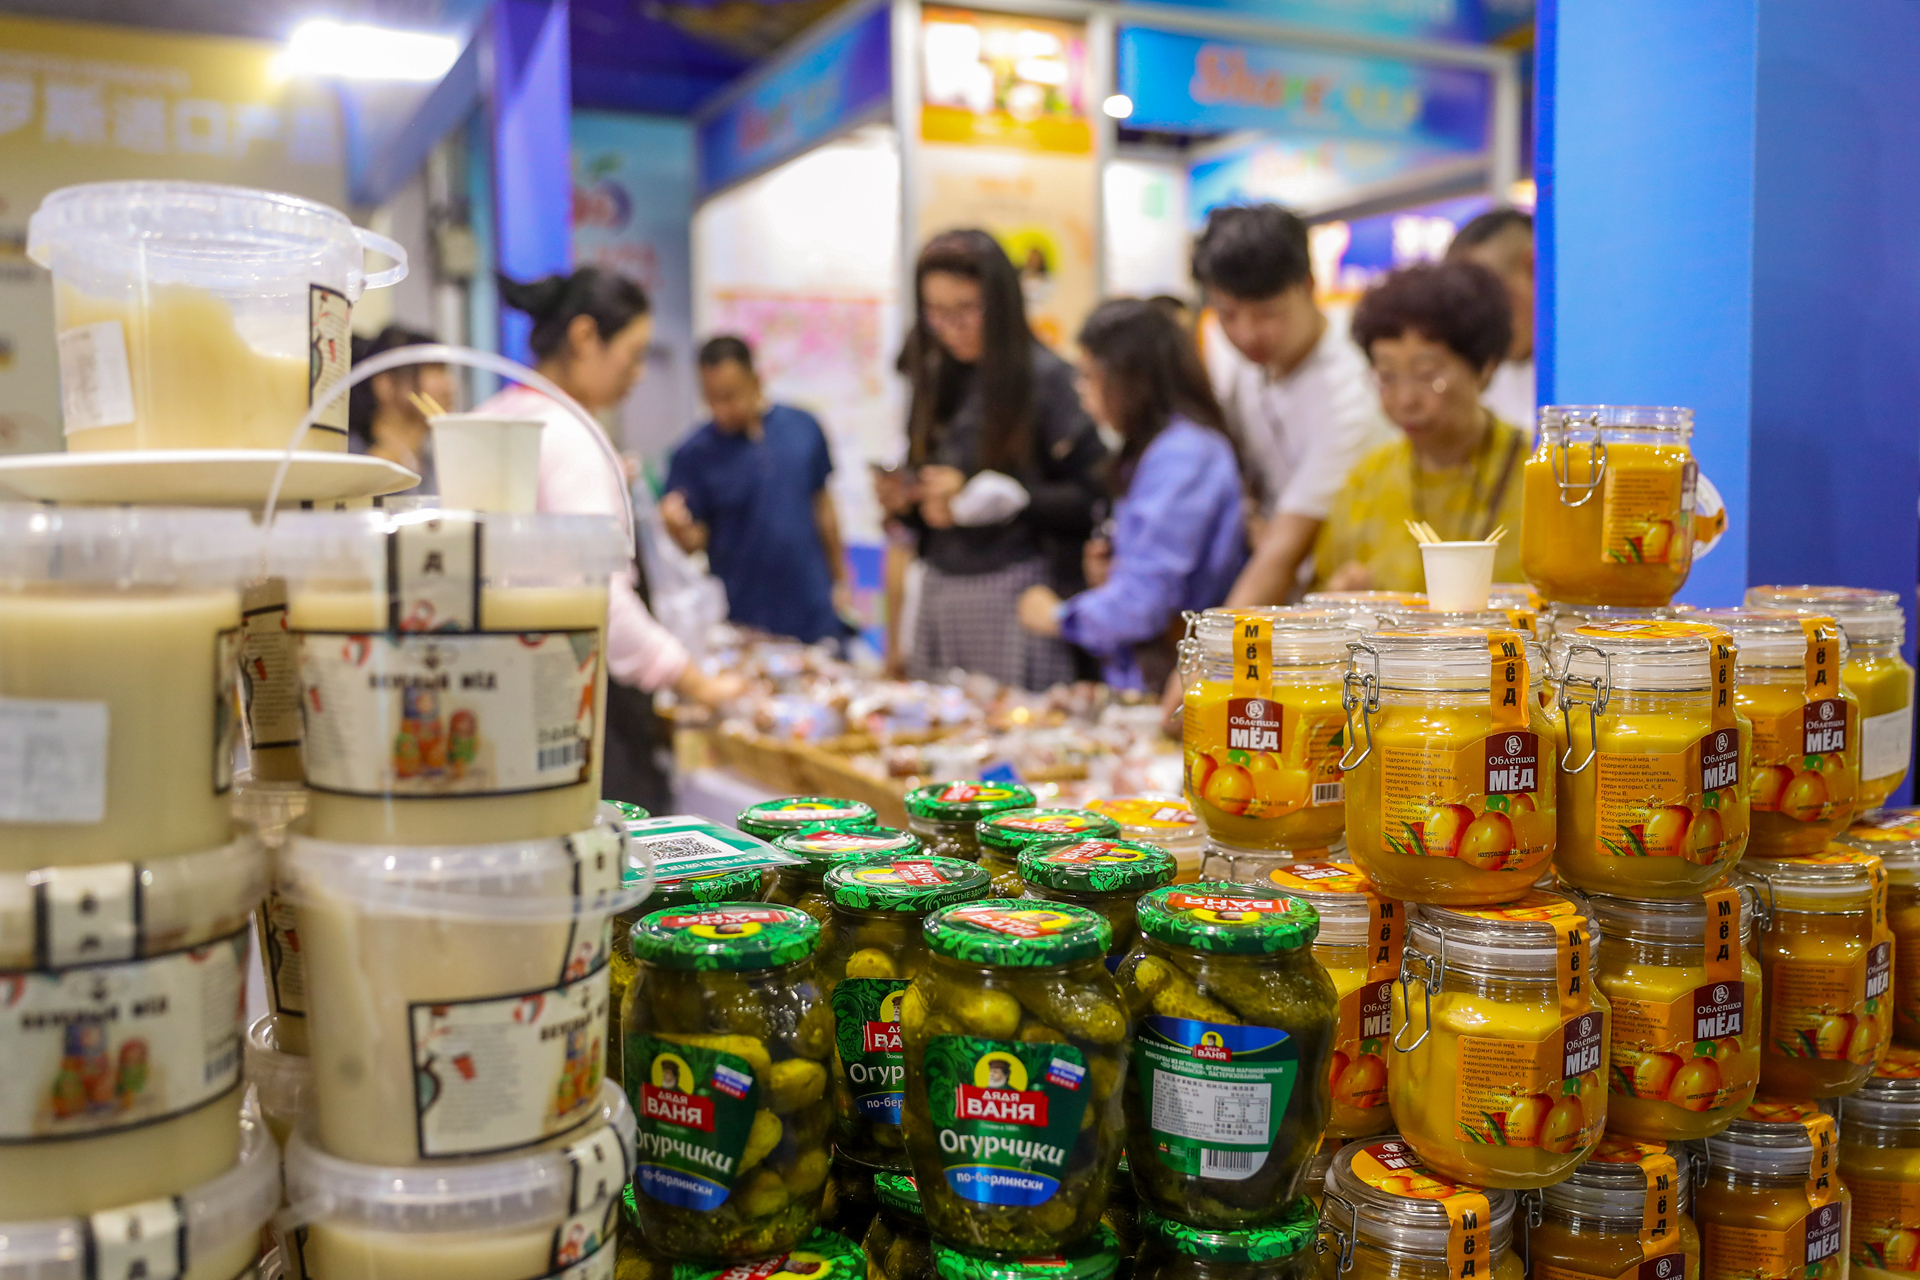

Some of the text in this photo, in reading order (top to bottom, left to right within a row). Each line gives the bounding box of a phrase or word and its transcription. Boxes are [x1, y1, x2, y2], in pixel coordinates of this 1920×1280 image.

[1244, 624, 1260, 681] Мёд
[1813, 629, 1828, 686] Мёд
[1501, 641, 1518, 707] Мёд
[1716, 643, 1730, 708] Мёд
[1230, 715, 1280, 728] Облепиха
[1805, 719, 1845, 730] Облепиха
[1230, 727, 1279, 750] МЁД
[1806, 728, 1844, 754] МЁД
[1489, 755, 1536, 766] Облепиха
[1703, 750, 1738, 765] Облепиха
[1489, 766, 1535, 792] МЁД
[1703, 762, 1737, 792] МЁД
[1058, 843, 1103, 860] ВАНЯ
[908, 863, 942, 883] ВАНЯ
[941, 891, 970, 903] ЧИСТЫЕ
[1184, 896, 1273, 909] ВАНЯ
[1204, 904, 1253, 912] ДЯДЯ
[678, 912, 771, 924] ВАНЯ
[967, 914, 1040, 936] ВАНЯ
[1377, 902, 1394, 963] Мёд
[1716, 901, 1731, 962] Мёд
[1568, 929, 1582, 997] Мёд
[1363, 1003, 1391, 1015] Обле
[1697, 1000, 1742, 1015] Облепиха
[887, 1025, 901, 1033] ДЯ
[1364, 1011, 1391, 1037] МЁ
[1697, 1012, 1741, 1039] МЁД
[874, 1033, 902, 1048] ВА
[1566, 1033, 1600, 1051] Облепиха
[1197, 1049, 1227, 1060] ВАНЯ
[1565, 1045, 1600, 1076] МЁД
[849, 1062, 905, 1085] Огур
[658, 1091, 688, 1105] ДЯДЯ
[867, 1097, 903, 1109] по-бер
[982, 1090, 1020, 1102] ДЯДЯ
[647, 1096, 703, 1125] ВАНЯ
[967, 1098, 1036, 1121] ВАНЯ
[939, 1128, 1066, 1167] Огурчики
[1815, 1130, 1831, 1190] Мёд
[643, 1169, 713, 1197] по-берлински
[956, 1171, 1044, 1191] по-берлински
[1651, 1174, 1670, 1238] Мёд
[1460, 1212, 1478, 1279] Мёд
[1807, 1232, 1840, 1263] МЁД
